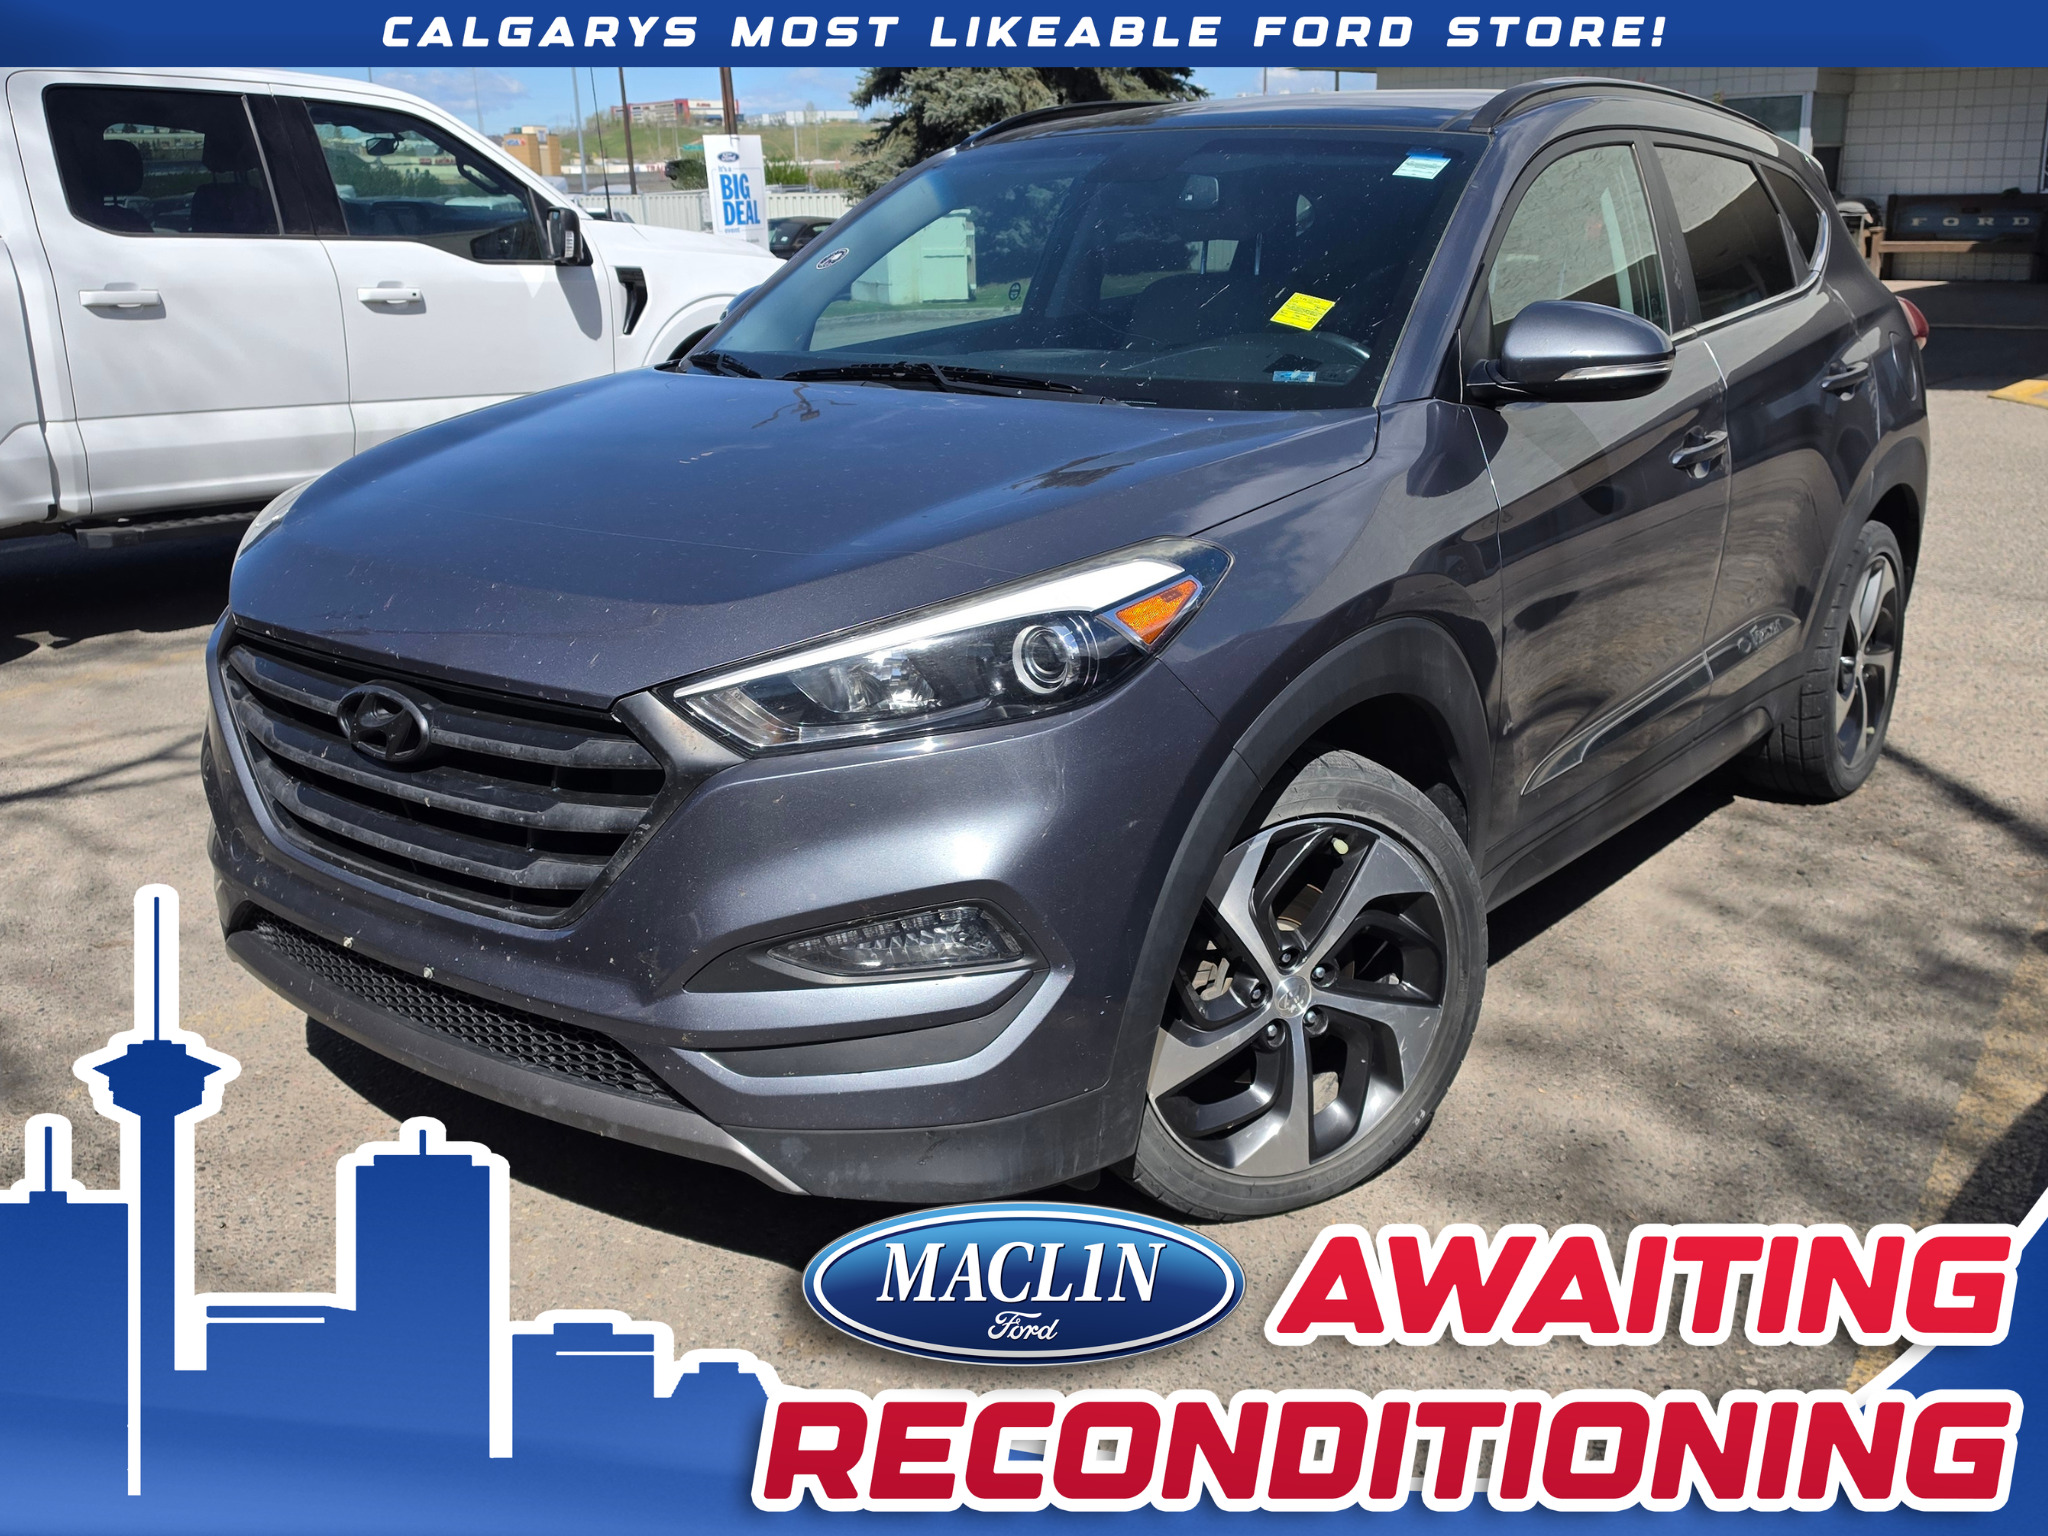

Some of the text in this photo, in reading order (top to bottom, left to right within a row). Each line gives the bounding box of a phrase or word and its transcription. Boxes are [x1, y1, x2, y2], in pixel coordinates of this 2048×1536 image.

[719, 173, 751, 200] BIG
[722, 200, 761, 226] DEAL
[1910, 216, 2031, 227] FORD
